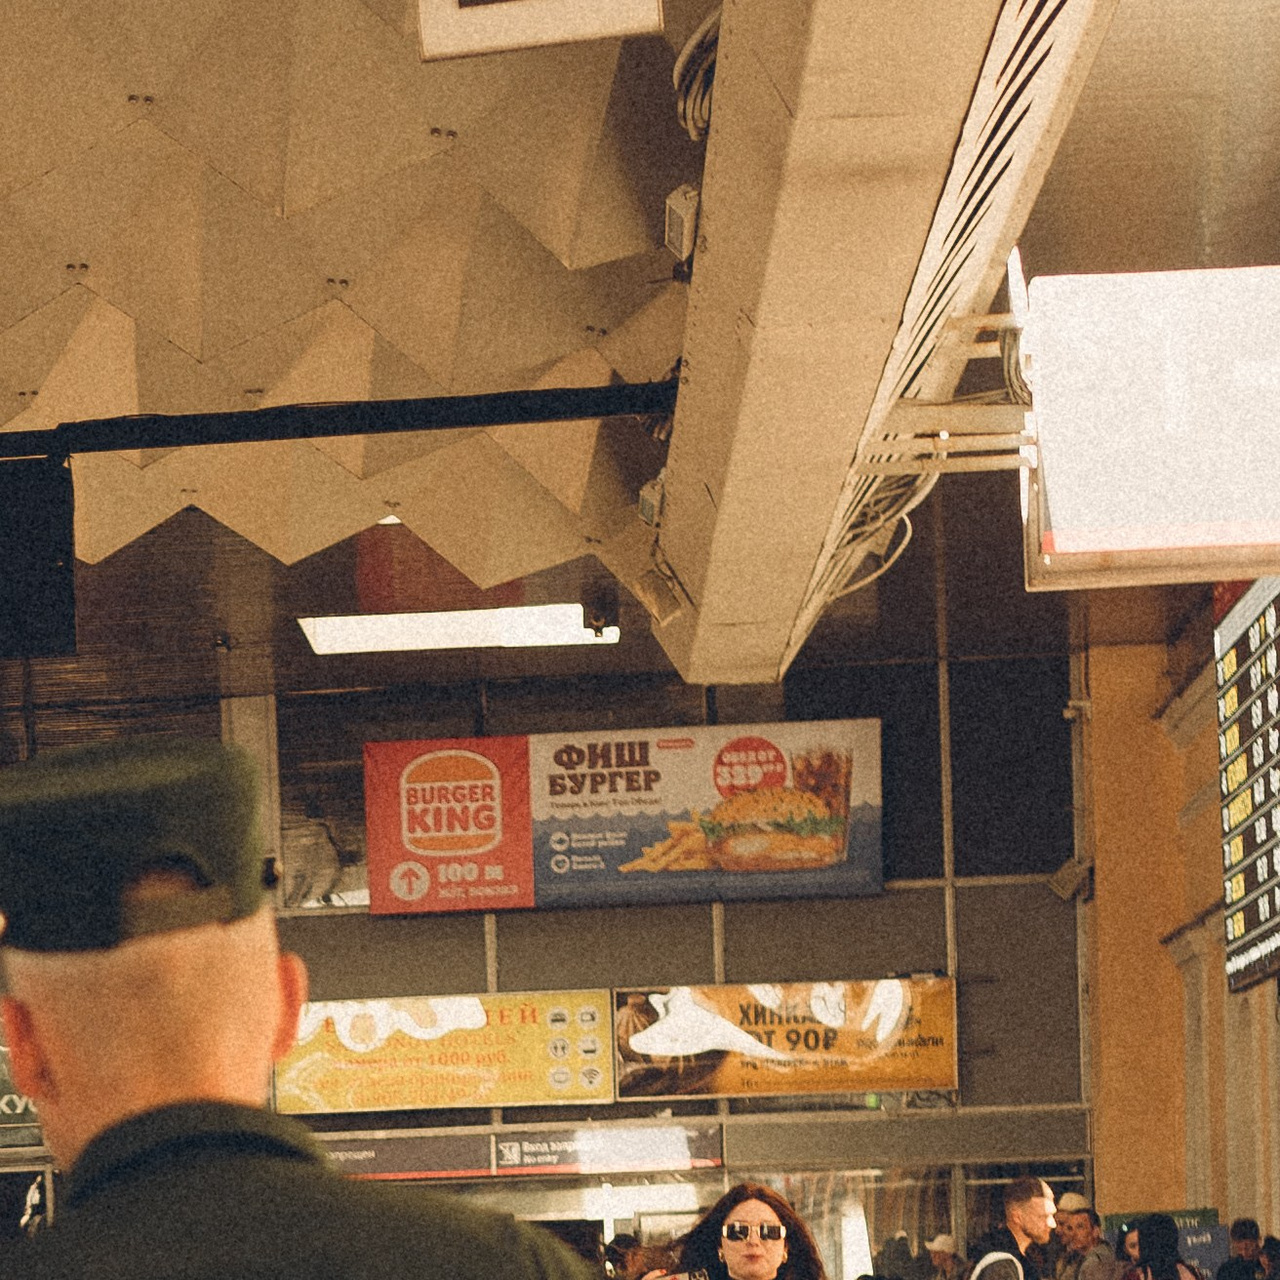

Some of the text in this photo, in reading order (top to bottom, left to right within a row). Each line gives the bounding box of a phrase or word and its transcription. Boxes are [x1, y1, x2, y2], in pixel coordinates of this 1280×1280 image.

[553, 741, 650, 771] ФИШ
[406, 783, 496, 806] BURGER
[549, 769, 662, 796] БУРГЕР
[407, 803, 497, 834] KING
